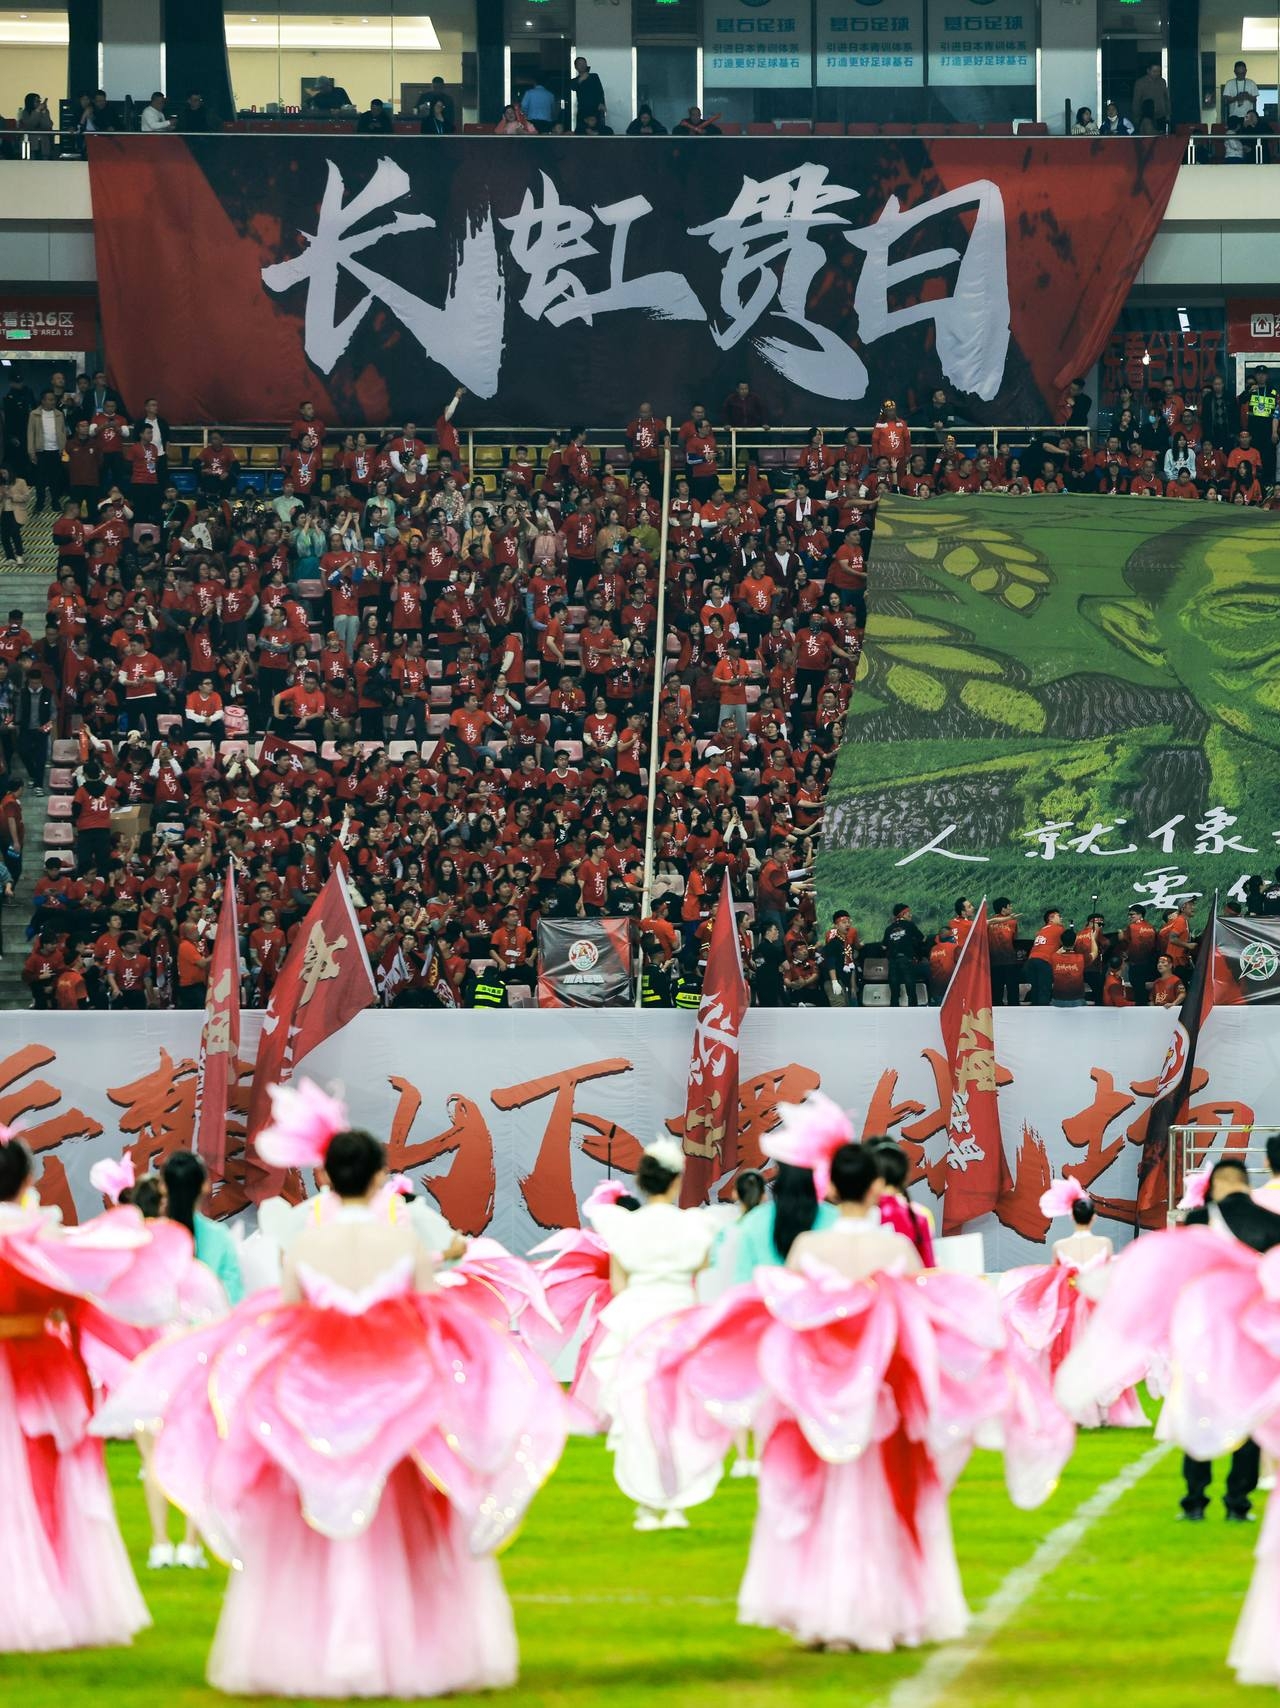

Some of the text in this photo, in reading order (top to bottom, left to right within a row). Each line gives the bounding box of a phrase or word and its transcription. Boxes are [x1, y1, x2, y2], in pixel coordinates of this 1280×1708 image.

[713, 57, 799, 68] 打造更好足球基石
[826, 56, 912, 67] 打造更好足球基石
[940, 55, 1026, 66] 打造更好足球基石
[261, 156, 1010, 402] 长虹贯日
[0, 311, 74, 328] 看台16区
[430, 547, 442, 567] 长沙
[225, 592, 240, 613] 长沙
[401, 592, 414, 614] 长沙
[806, 636, 820, 656] 长沙
